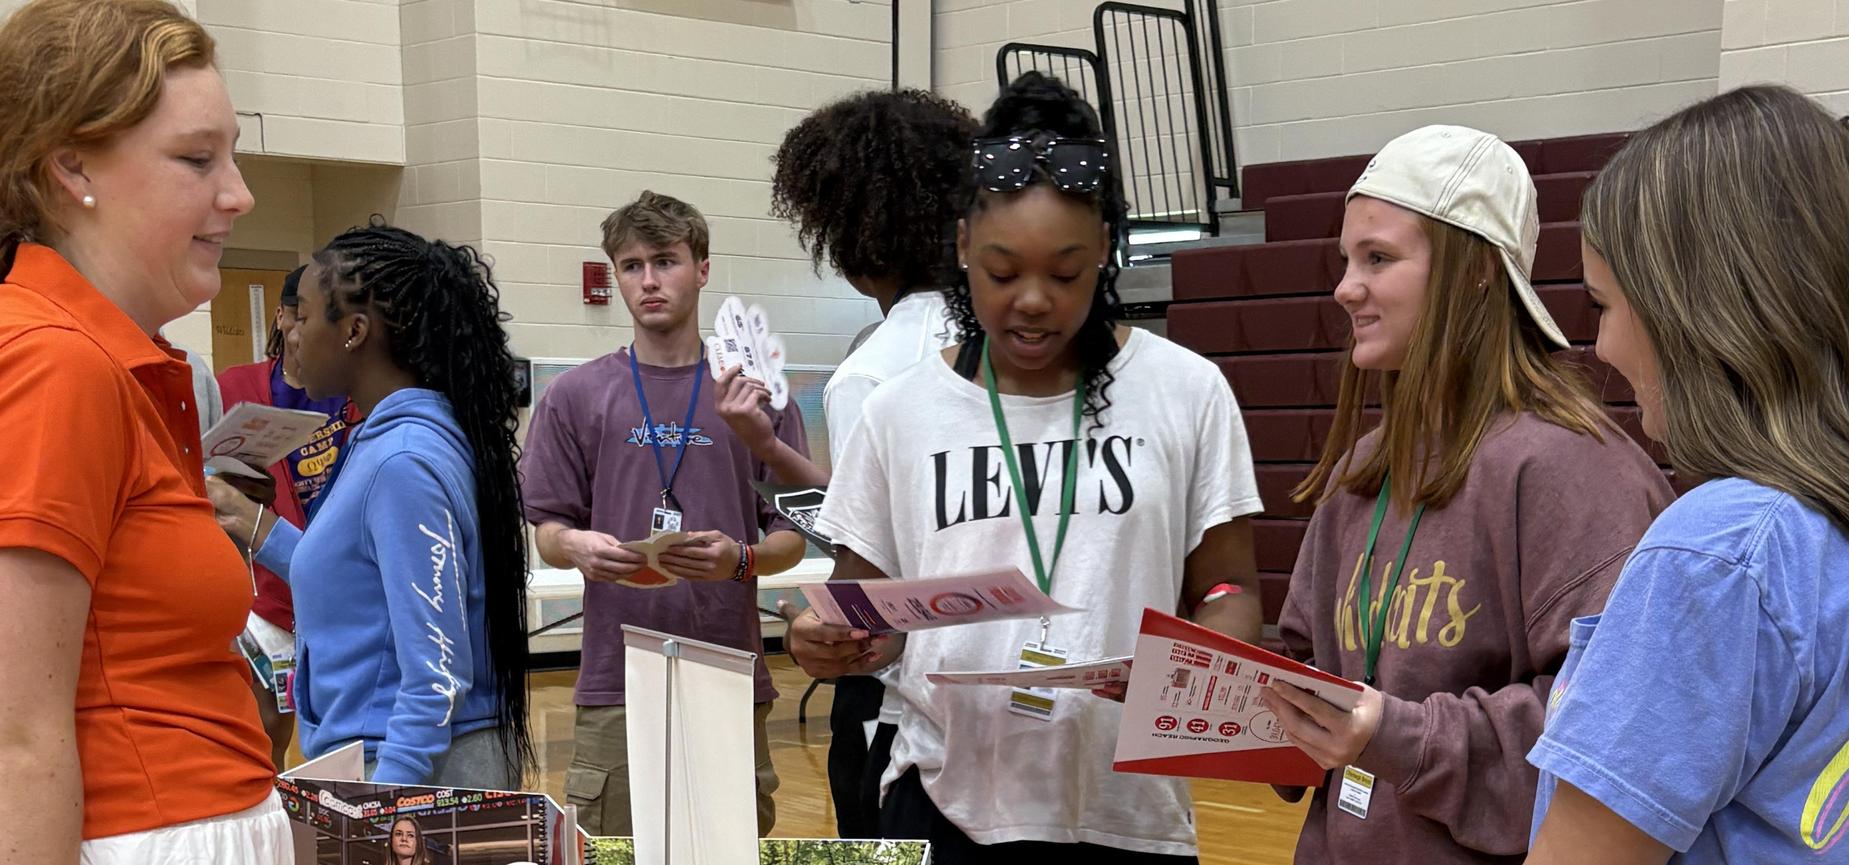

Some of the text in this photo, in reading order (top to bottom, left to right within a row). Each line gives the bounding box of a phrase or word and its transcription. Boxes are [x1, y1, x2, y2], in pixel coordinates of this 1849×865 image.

[1159, 717, 1174, 730] 91
[1222, 724, 1237, 736] 31
[436, 789, 454, 799] COST
[397, 794, 435, 808] COSTCO
